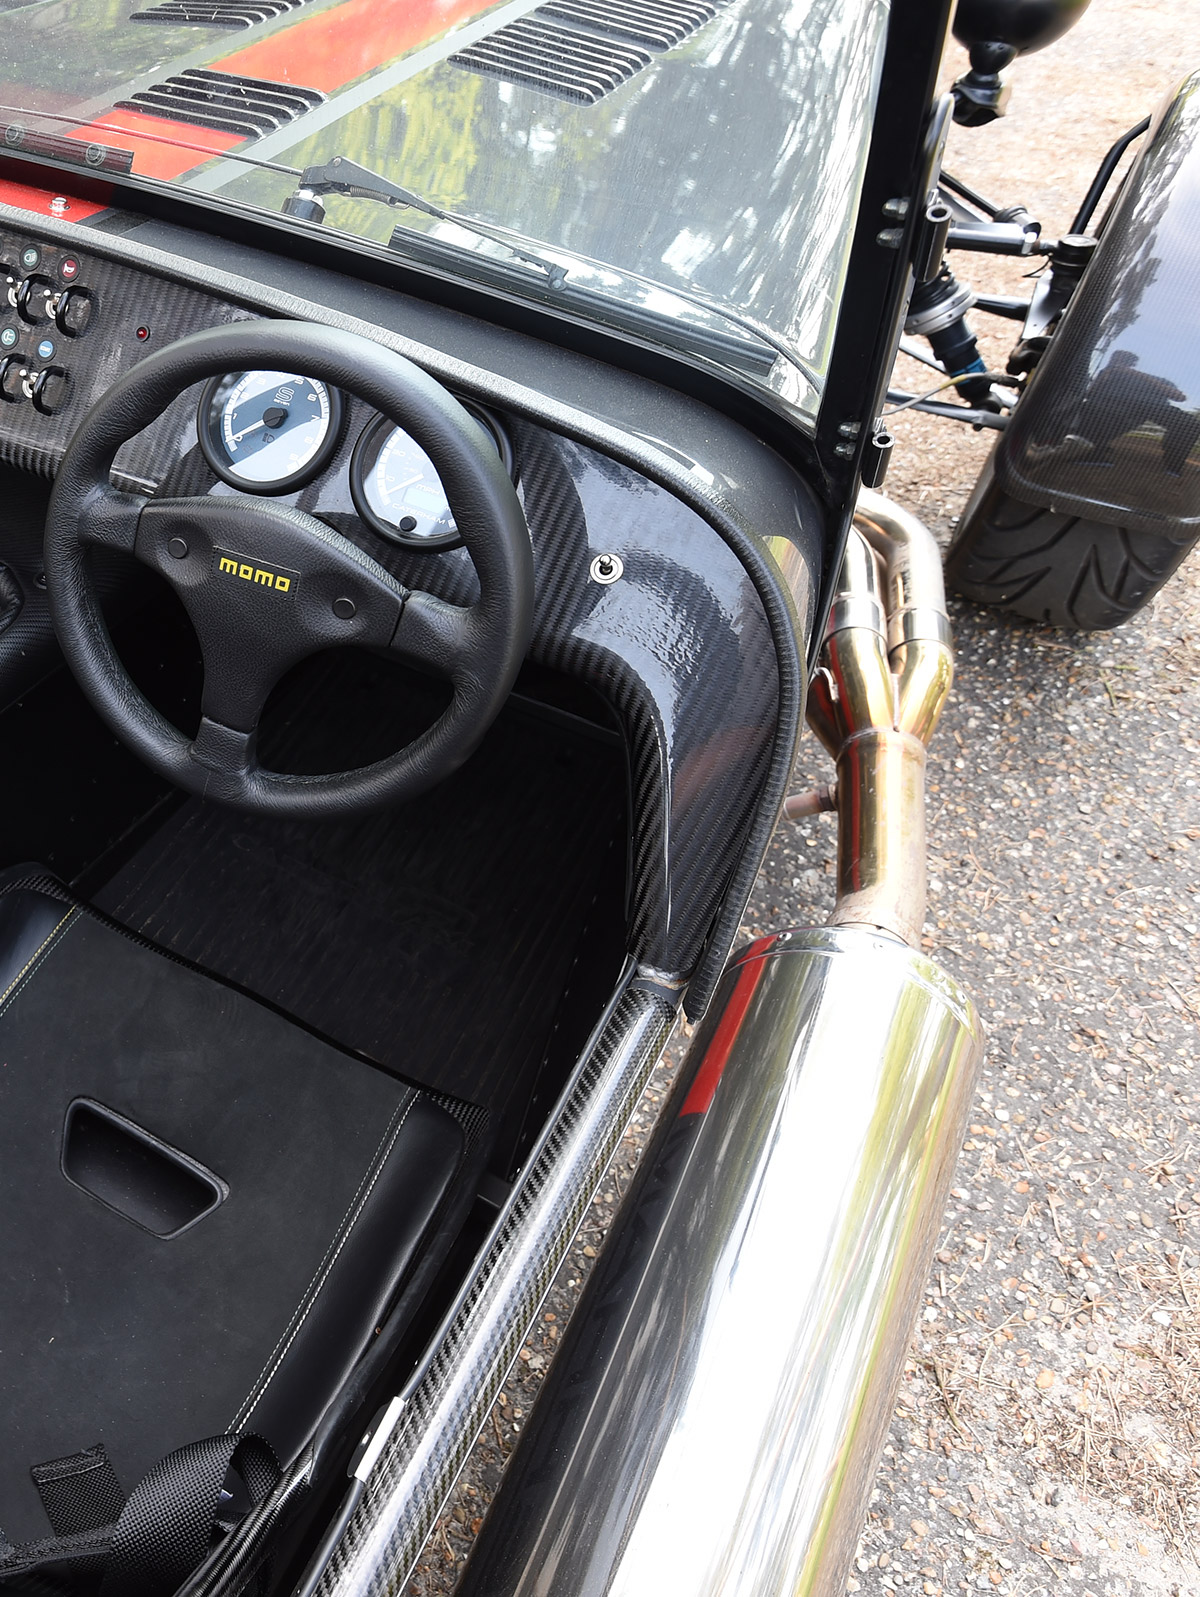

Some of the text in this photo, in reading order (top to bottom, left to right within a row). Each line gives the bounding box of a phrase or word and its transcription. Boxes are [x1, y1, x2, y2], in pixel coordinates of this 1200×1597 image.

[276, 386, 295, 402] S
[307, 393, 318, 402] 6
[415, 484, 441, 495] MPH
[392, 503, 446, 525] CATERHAM
